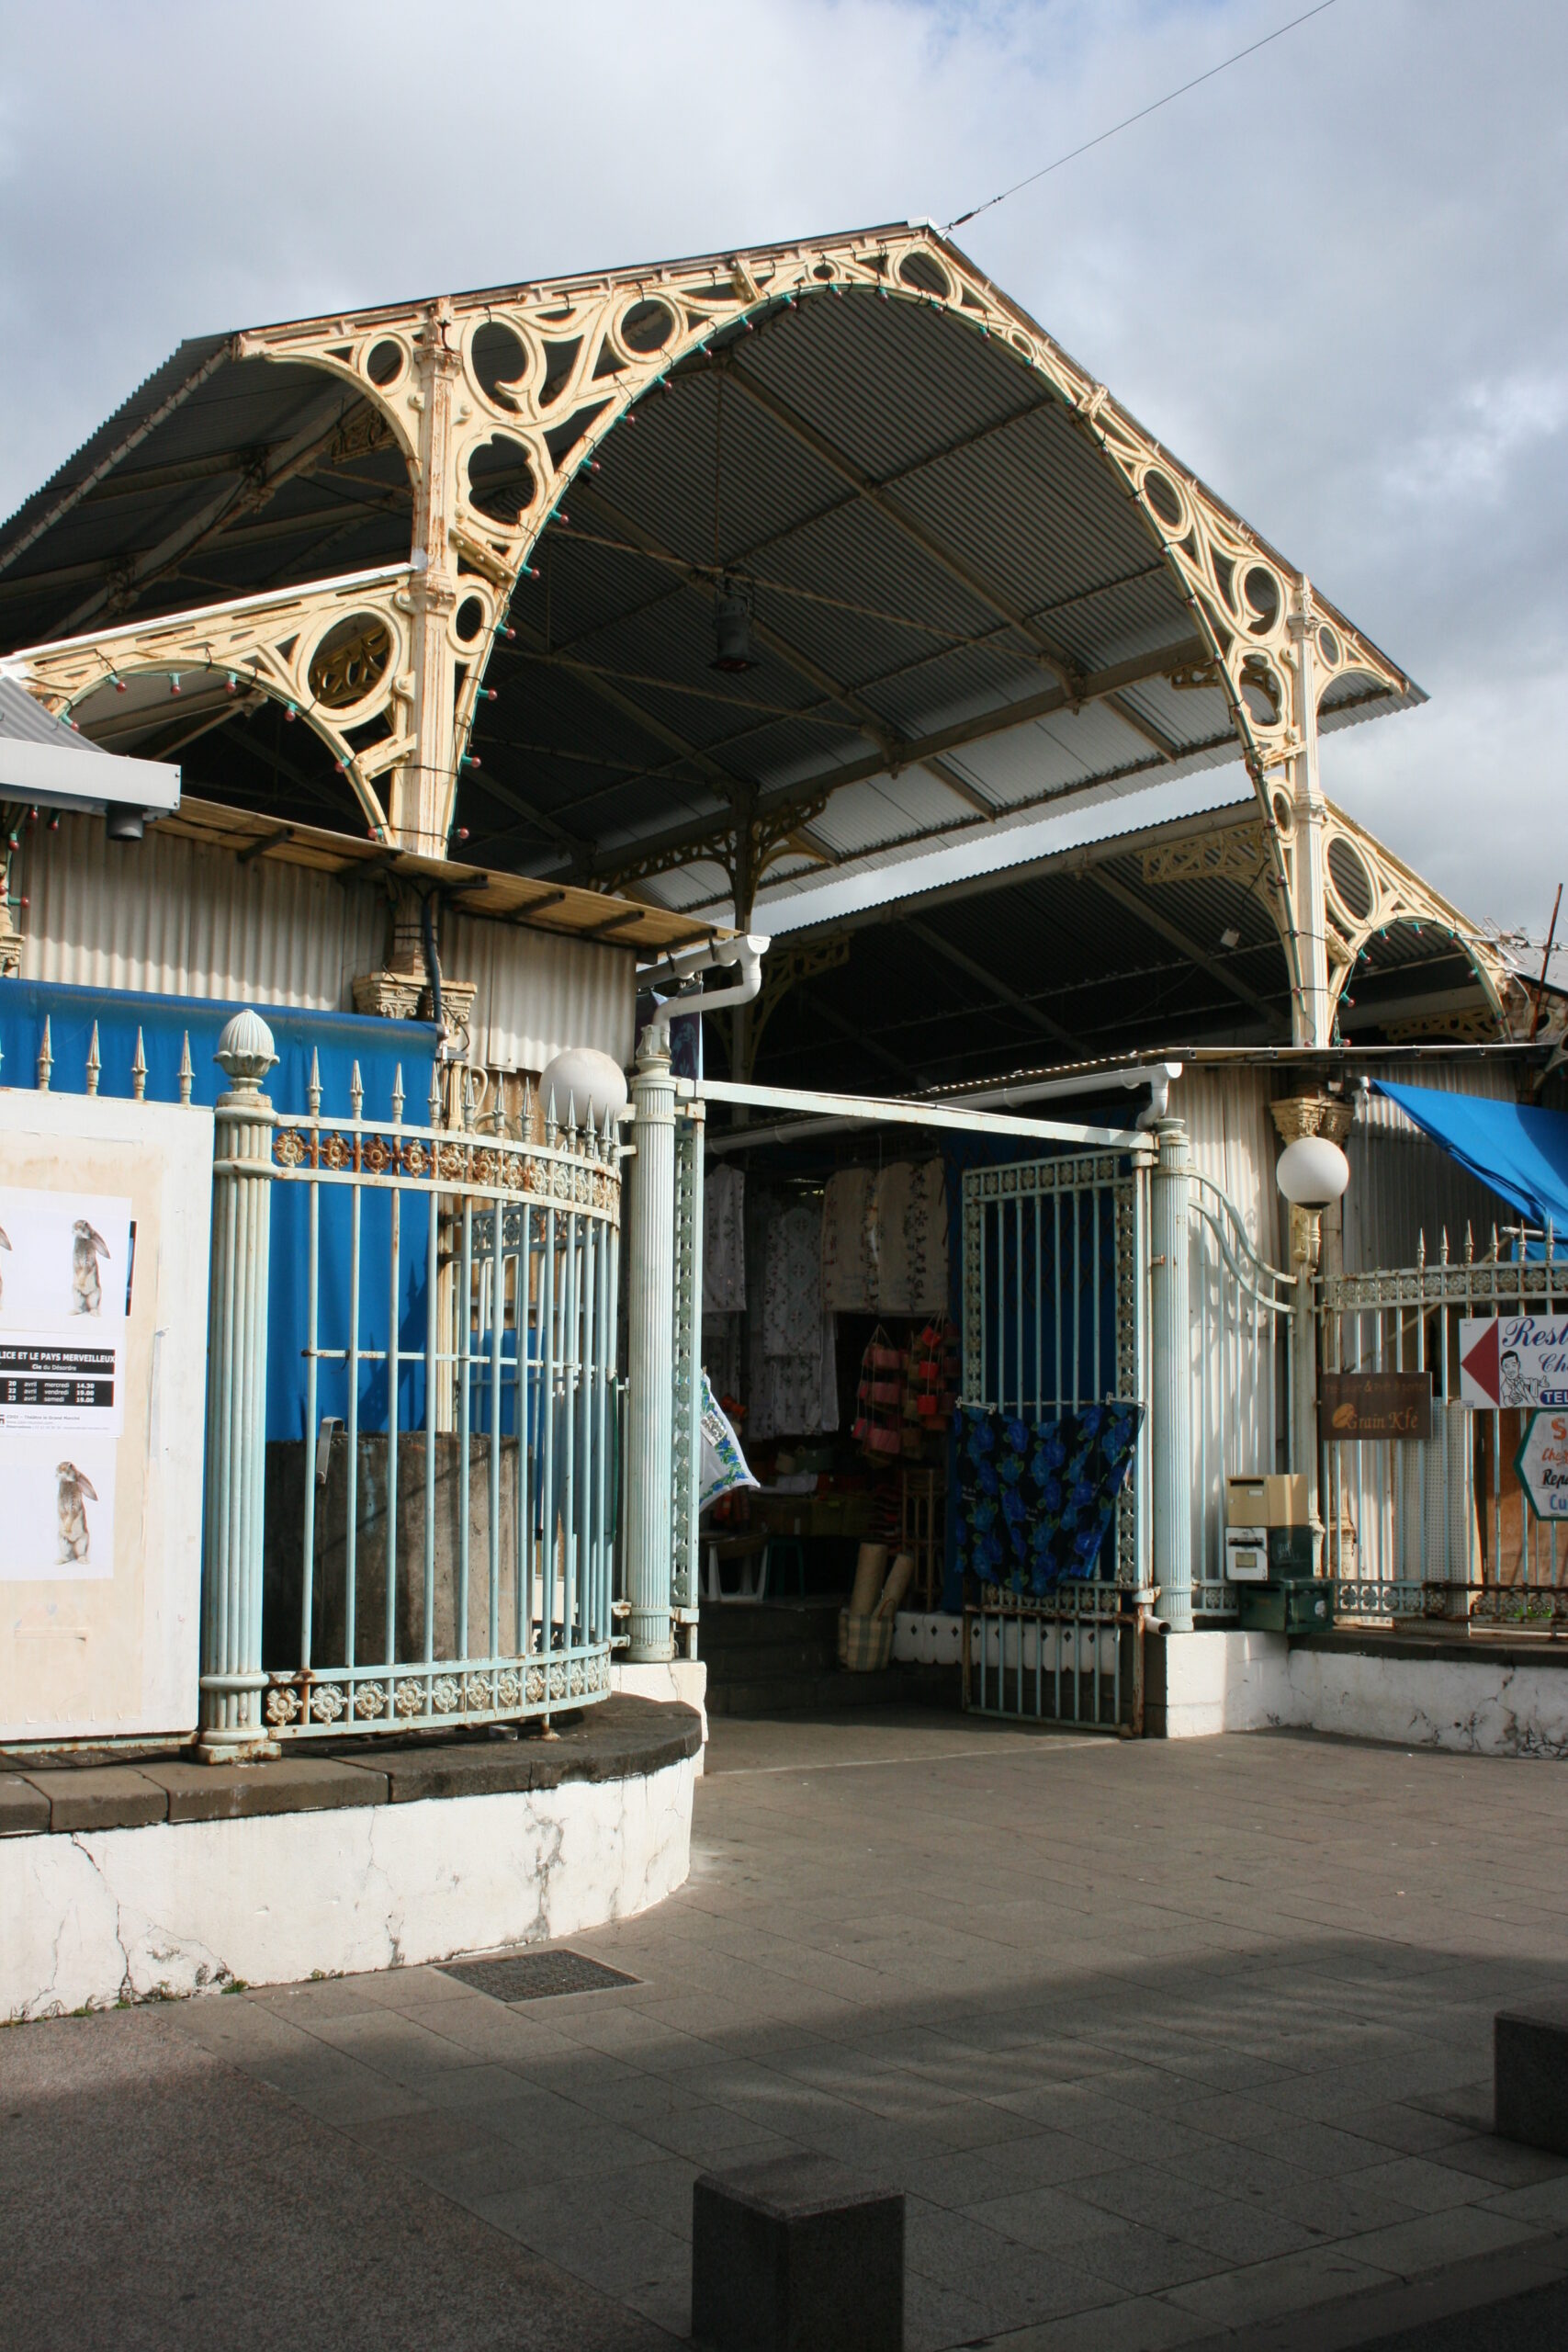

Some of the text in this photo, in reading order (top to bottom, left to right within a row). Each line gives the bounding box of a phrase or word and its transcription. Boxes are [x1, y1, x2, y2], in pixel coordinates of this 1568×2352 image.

[40, 1352, 61, 1362] PAYS
[62, 1353, 115, 1363] MERVEILLEUX
[1539, 1353, 1568, 1373] Ch
